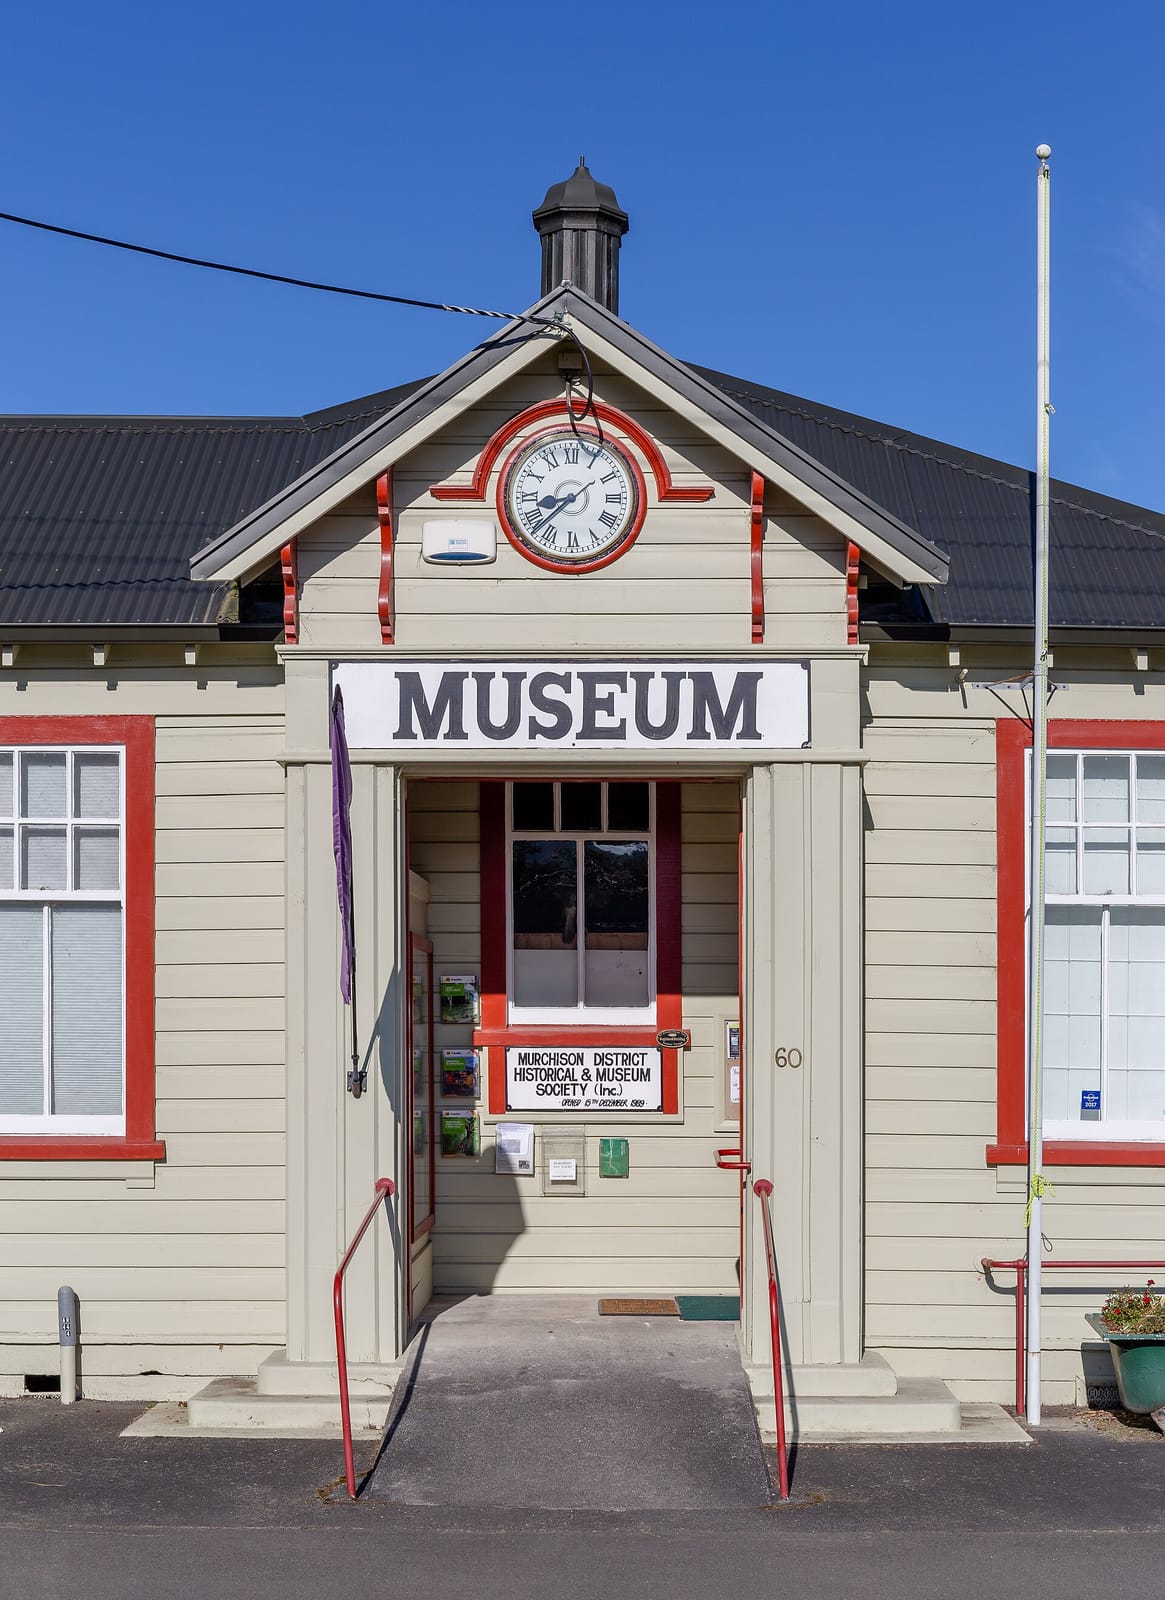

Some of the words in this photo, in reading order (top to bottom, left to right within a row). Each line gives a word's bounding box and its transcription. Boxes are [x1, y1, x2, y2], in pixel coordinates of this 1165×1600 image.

[543, 452, 560, 471] XI
[564, 448, 579, 464] XII
[587, 450, 599, 469] I
[527, 470, 544, 483] X
[600, 471, 616, 484] II
[522, 491, 538, 503] IX
[606, 493, 621, 504] III
[541, 523, 557, 545] VII
[567, 531, 579, 547] VI
[589, 528, 600, 543] V
[392, 670, 764, 741] MUSEUM
[518, 1052, 584, 1066] MURCHISON
[593, 1052, 648, 1066] DISTRICT
[775, 1047, 802, 1068] 60
[514, 1067, 578, 1082] HISTORICAL
[581, 1067, 592, 1082] &
[595, 1067, 651, 1082] MUSEUM
[536, 1083, 587, 1096] SOCIETY
[594, 1083, 623, 1097] (Inc.)
